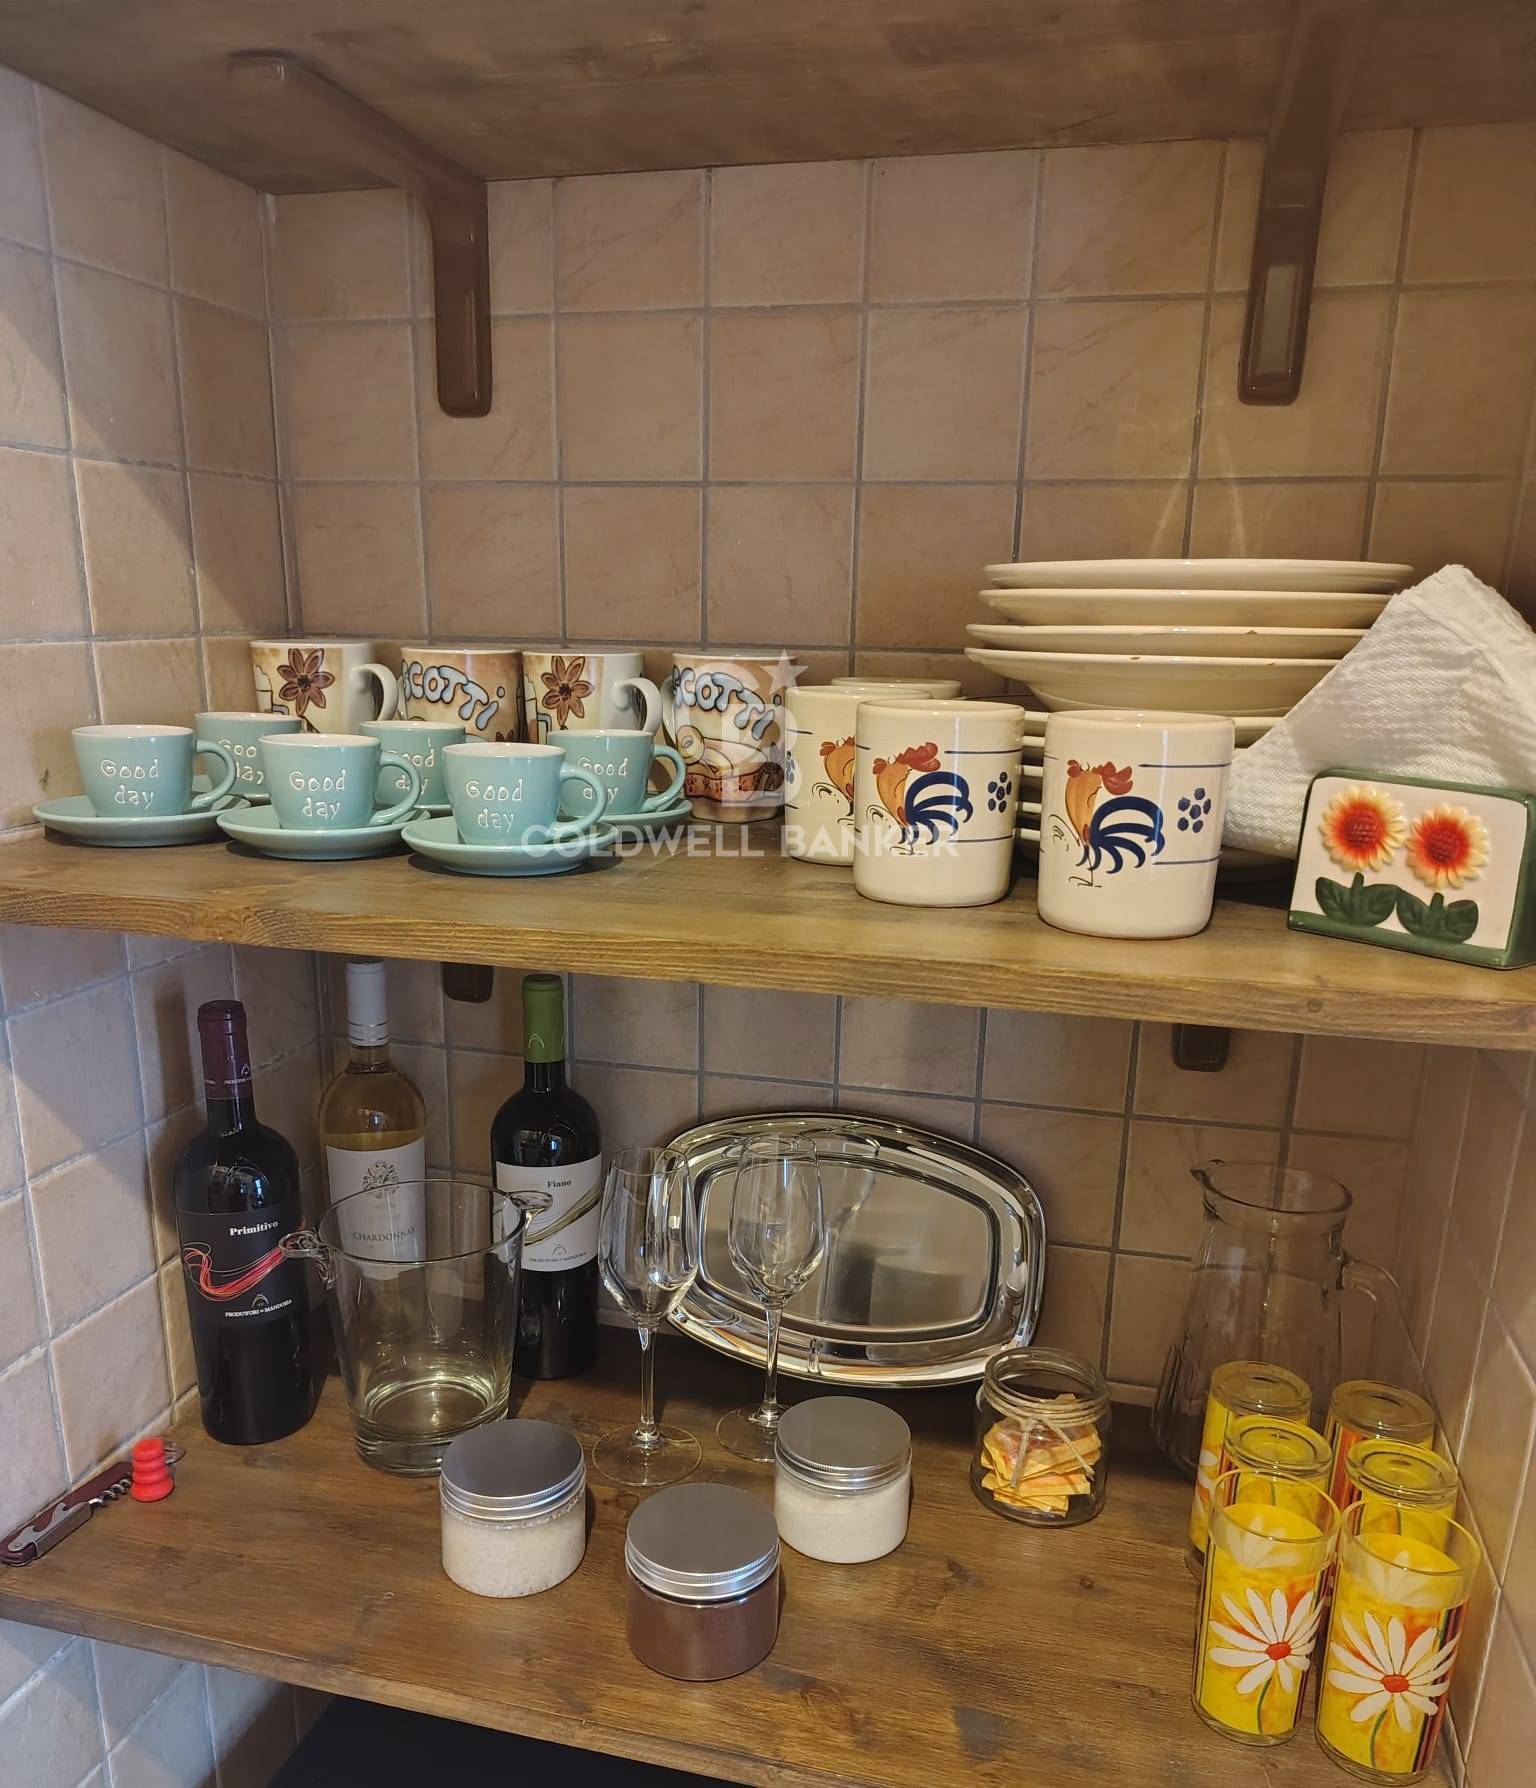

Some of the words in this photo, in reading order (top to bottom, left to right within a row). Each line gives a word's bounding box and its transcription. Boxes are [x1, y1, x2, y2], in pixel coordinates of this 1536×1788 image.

[100, 758, 159, 779] Good
[289, 769, 346, 792] Good
[465, 778, 523, 802] Good
[114, 784, 155, 810] day
[302, 797, 341, 820] day
[477, 808, 515, 833] day
[547, 1180, 572, 1188] Fiano
[229, 1220, 279, 1236] Primitivo
[351, 1225, 416, 1241] CHARDONNAY
